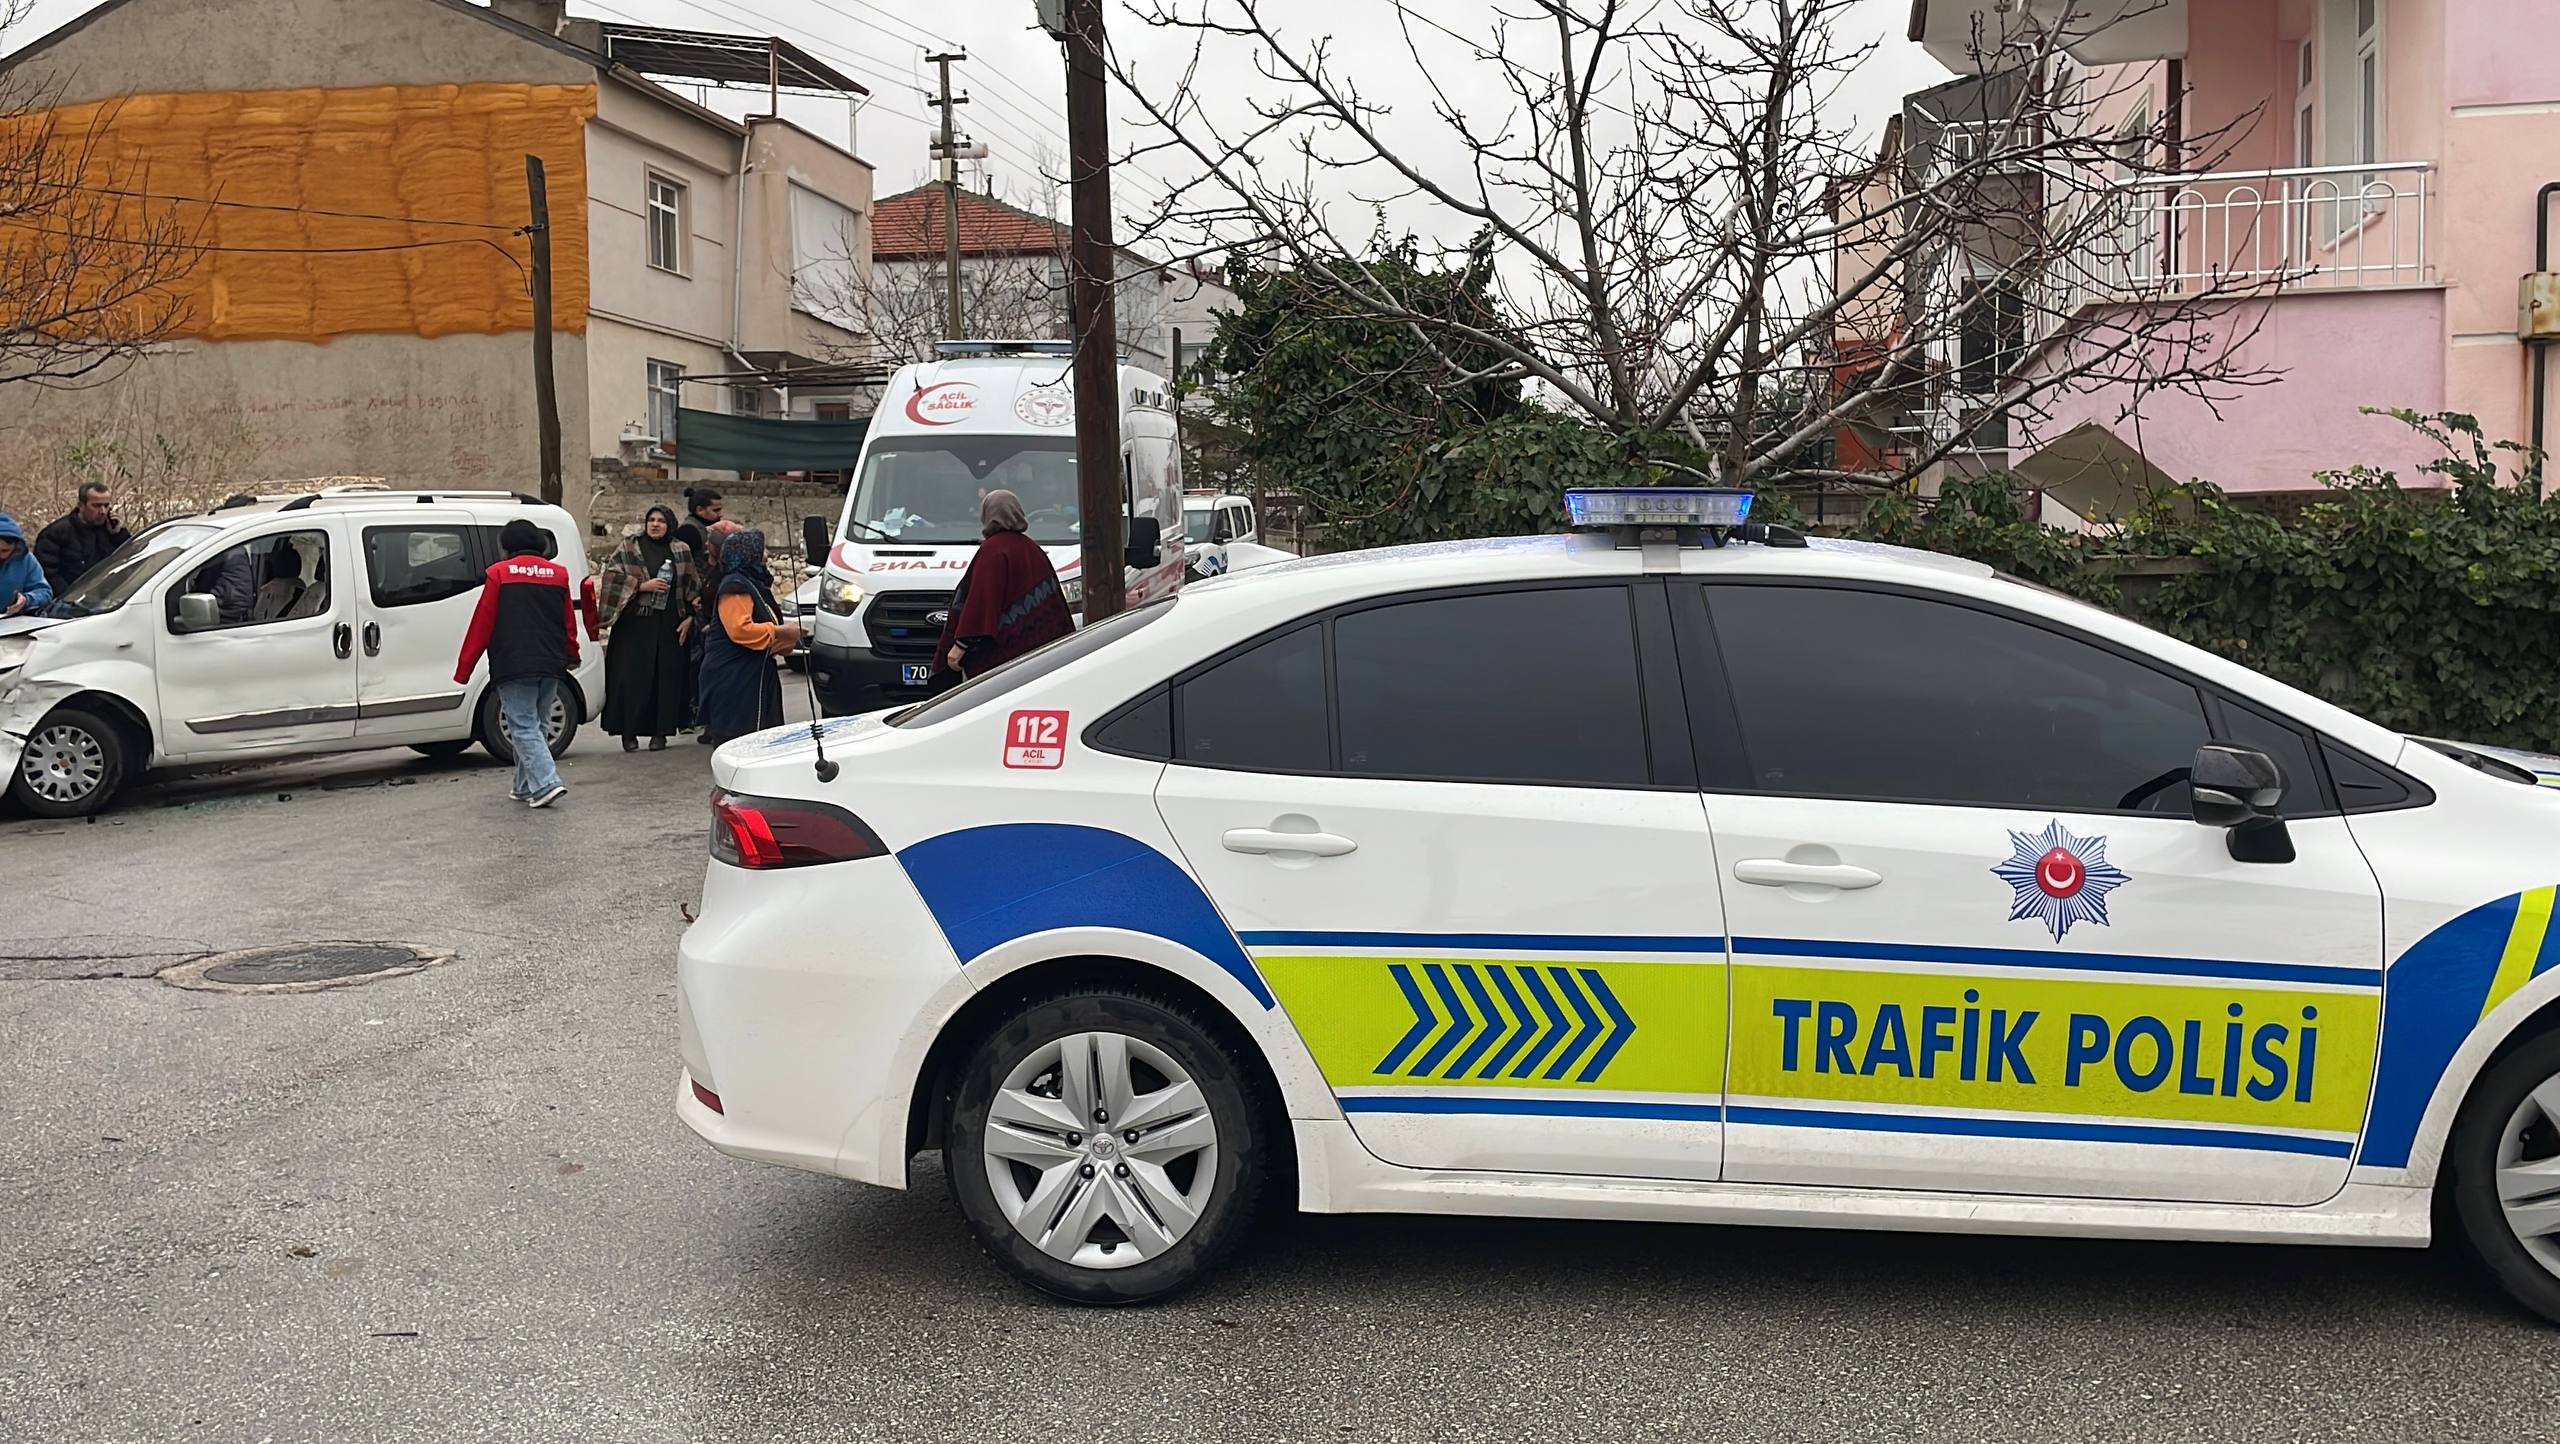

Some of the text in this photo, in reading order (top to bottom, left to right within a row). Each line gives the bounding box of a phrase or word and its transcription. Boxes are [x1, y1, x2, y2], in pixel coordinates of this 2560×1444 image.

[940, 391, 967, 400] ACİL
[927, 400, 973, 410] SAĞLIK
[911, 666, 927, 679] 70
[1017, 716, 1059, 744] 112
[1773, 989, 2317, 1103] TRAFİK POLİSİ
